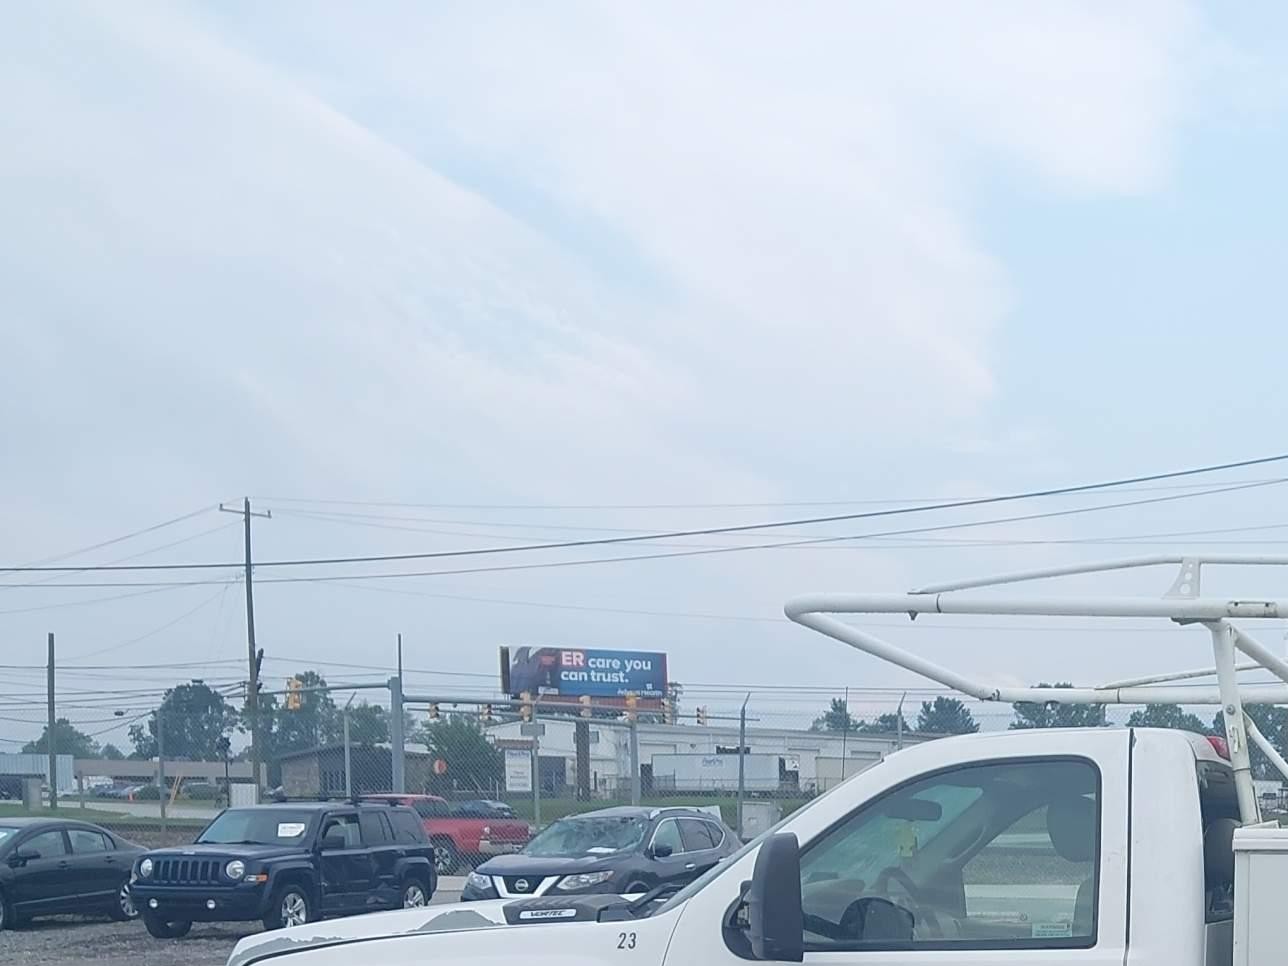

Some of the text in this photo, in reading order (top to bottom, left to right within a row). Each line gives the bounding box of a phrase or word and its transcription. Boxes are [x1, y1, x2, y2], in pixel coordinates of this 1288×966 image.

[561, 651, 651, 673] ER care you
[561, 670, 629, 683] can trust.
[617, 932, 637, 949] 23
